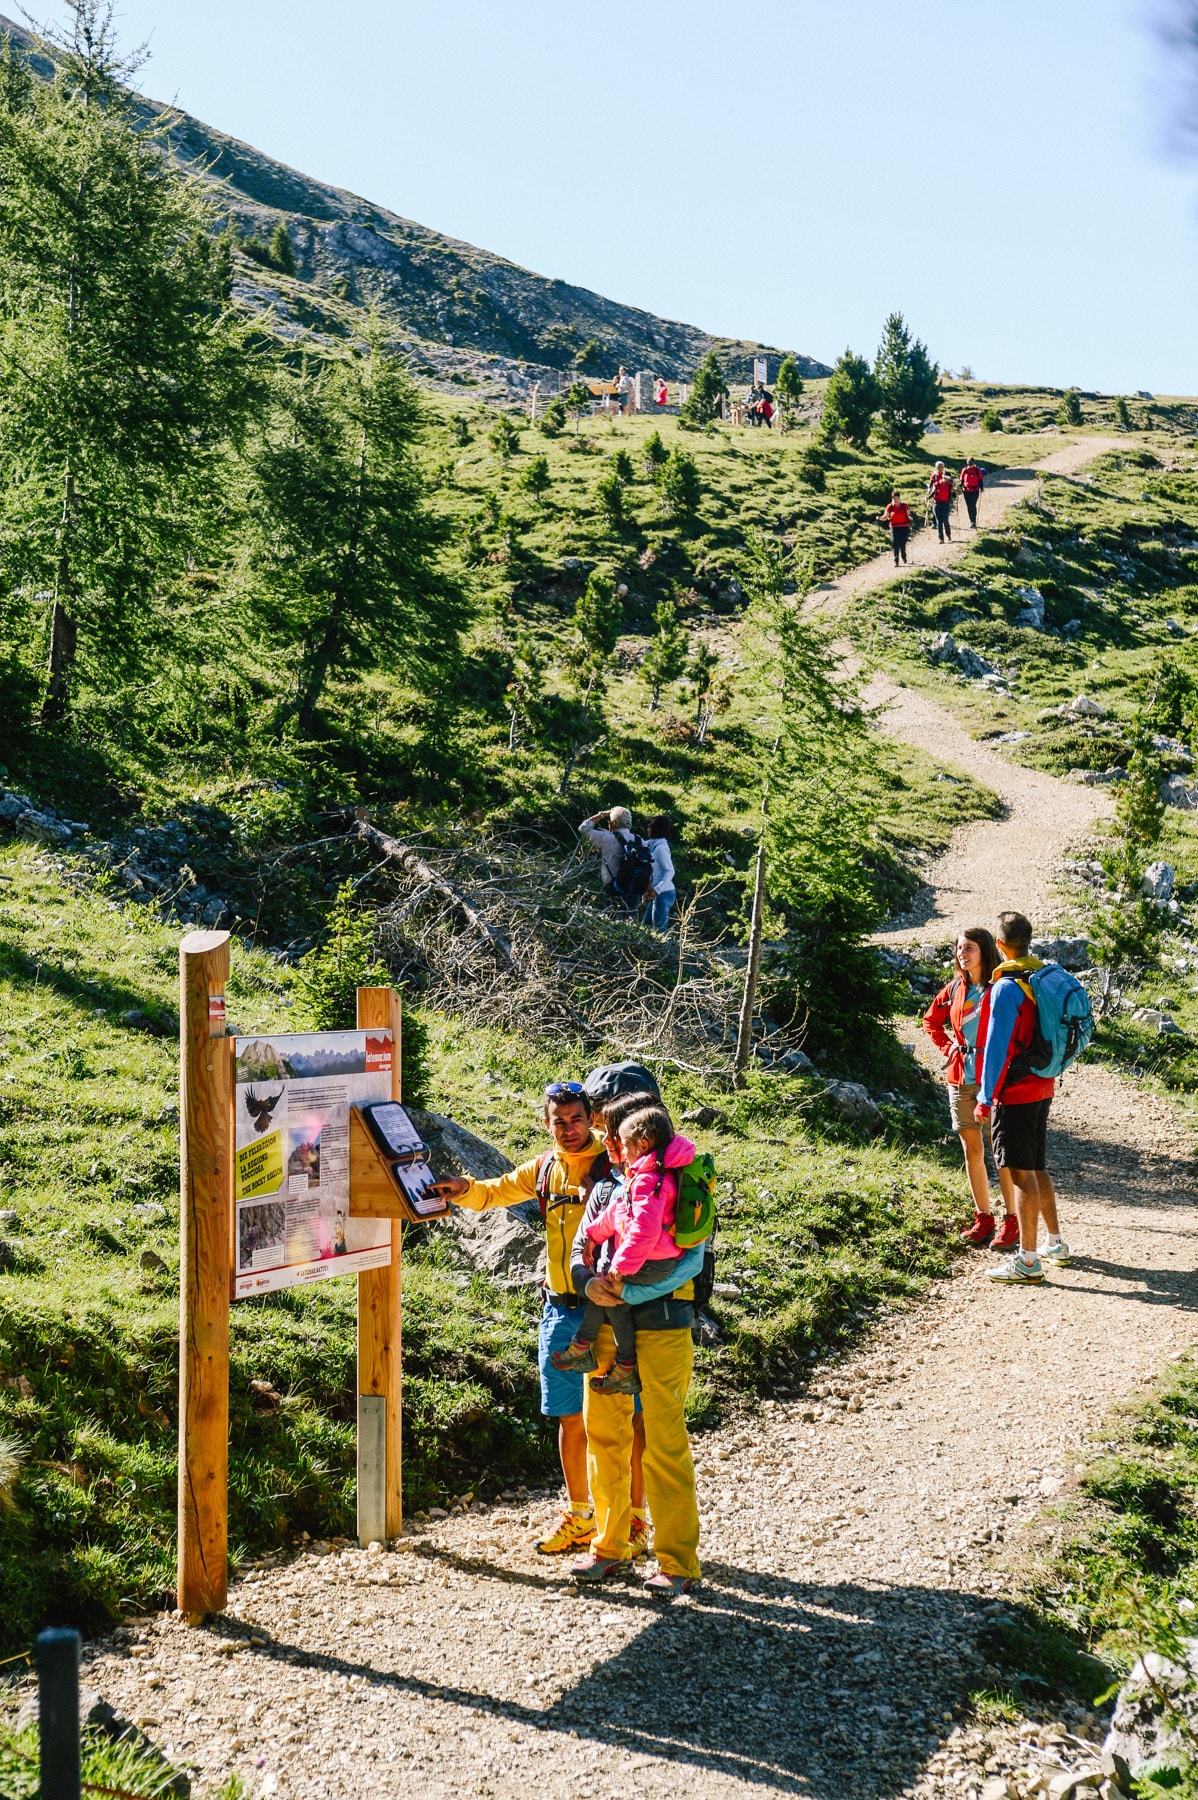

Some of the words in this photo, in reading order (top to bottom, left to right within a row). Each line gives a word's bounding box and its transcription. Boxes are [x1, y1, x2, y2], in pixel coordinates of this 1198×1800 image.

[239, 1151, 248, 1163] DIE
[248, 1136, 277, 1157] FELSREGION
[240, 1164, 247, 1174] LA
[247, 1152, 268, 1170] REGIONE
[241, 1164, 264, 1182] ROCCIOSA
[242, 1184, 251, 1195] THE
[251, 1176, 266, 1190] ROCKY
[266, 1166, 283, 1181] REGION
